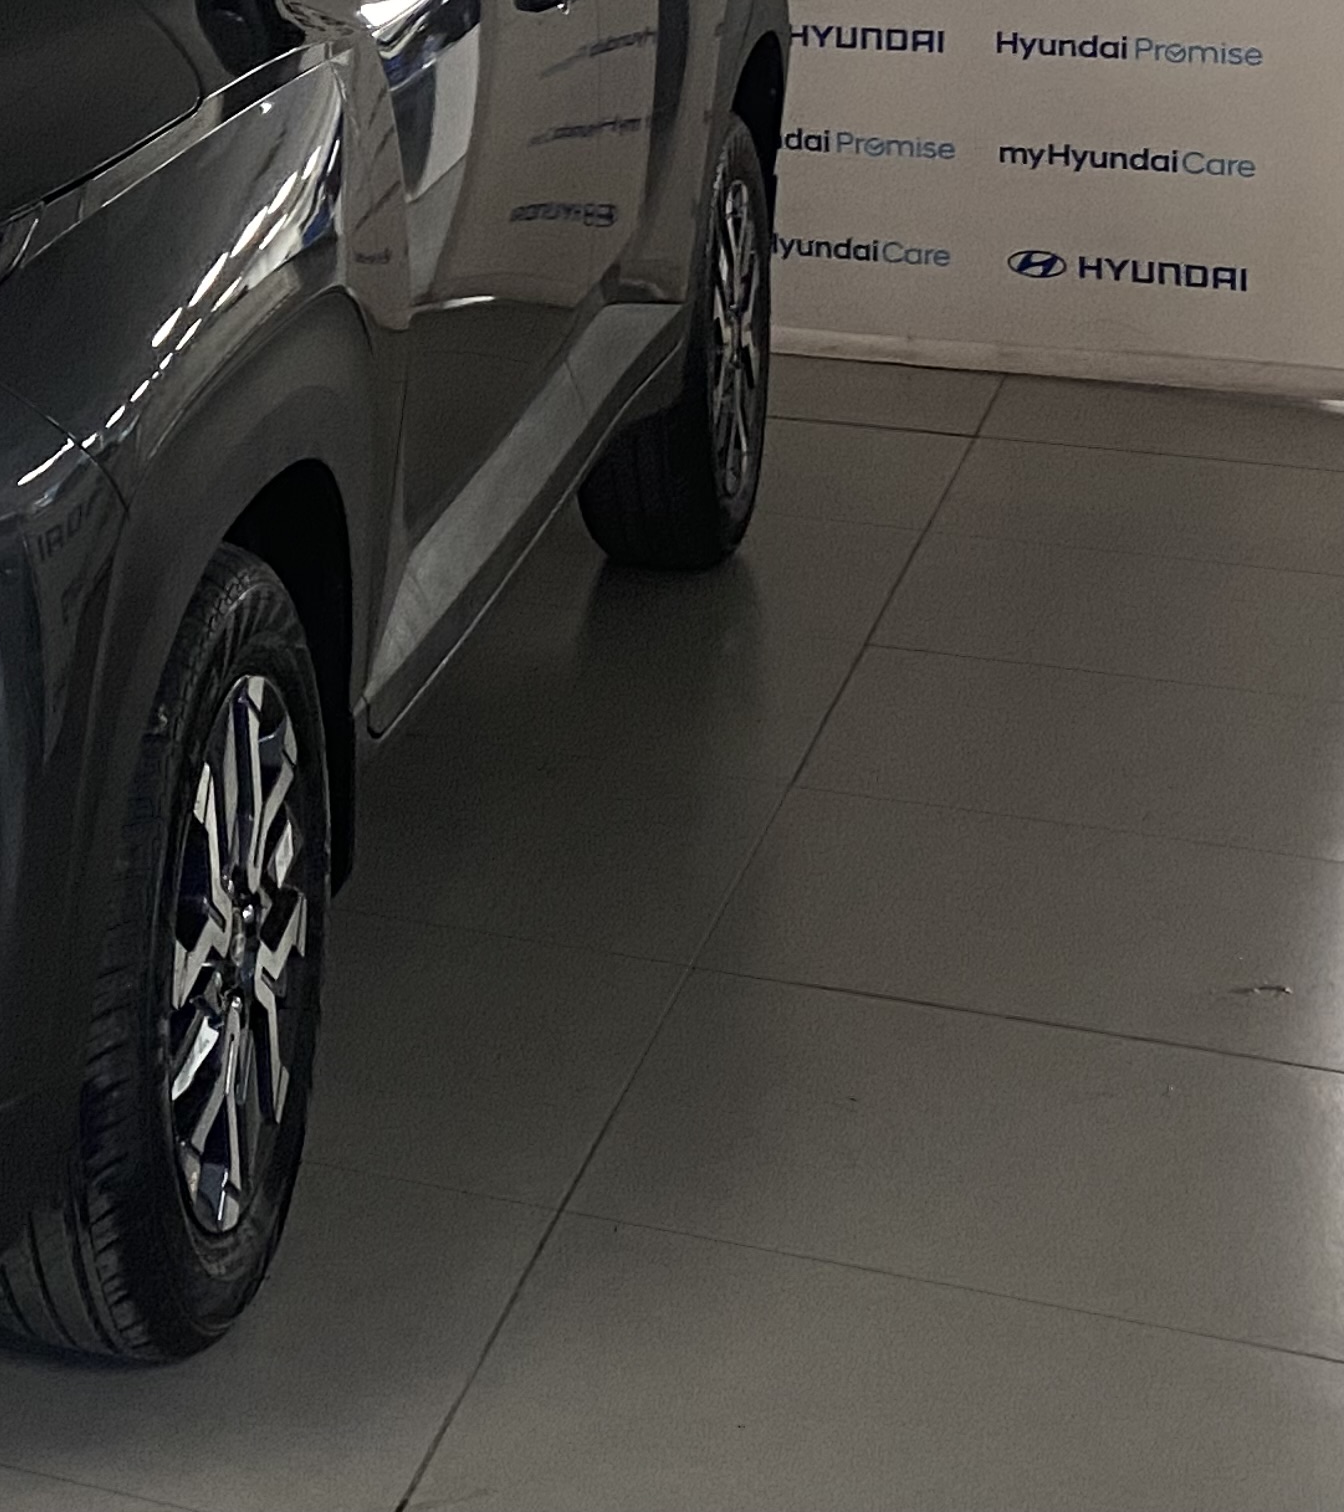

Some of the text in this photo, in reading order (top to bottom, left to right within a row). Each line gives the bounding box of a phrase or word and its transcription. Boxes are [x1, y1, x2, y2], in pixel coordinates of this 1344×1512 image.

[996, 30, 1264, 68] Hyundai Promise
[836, 131, 956, 160] Promise
[1078, 255, 1248, 292] HYUNDAI
